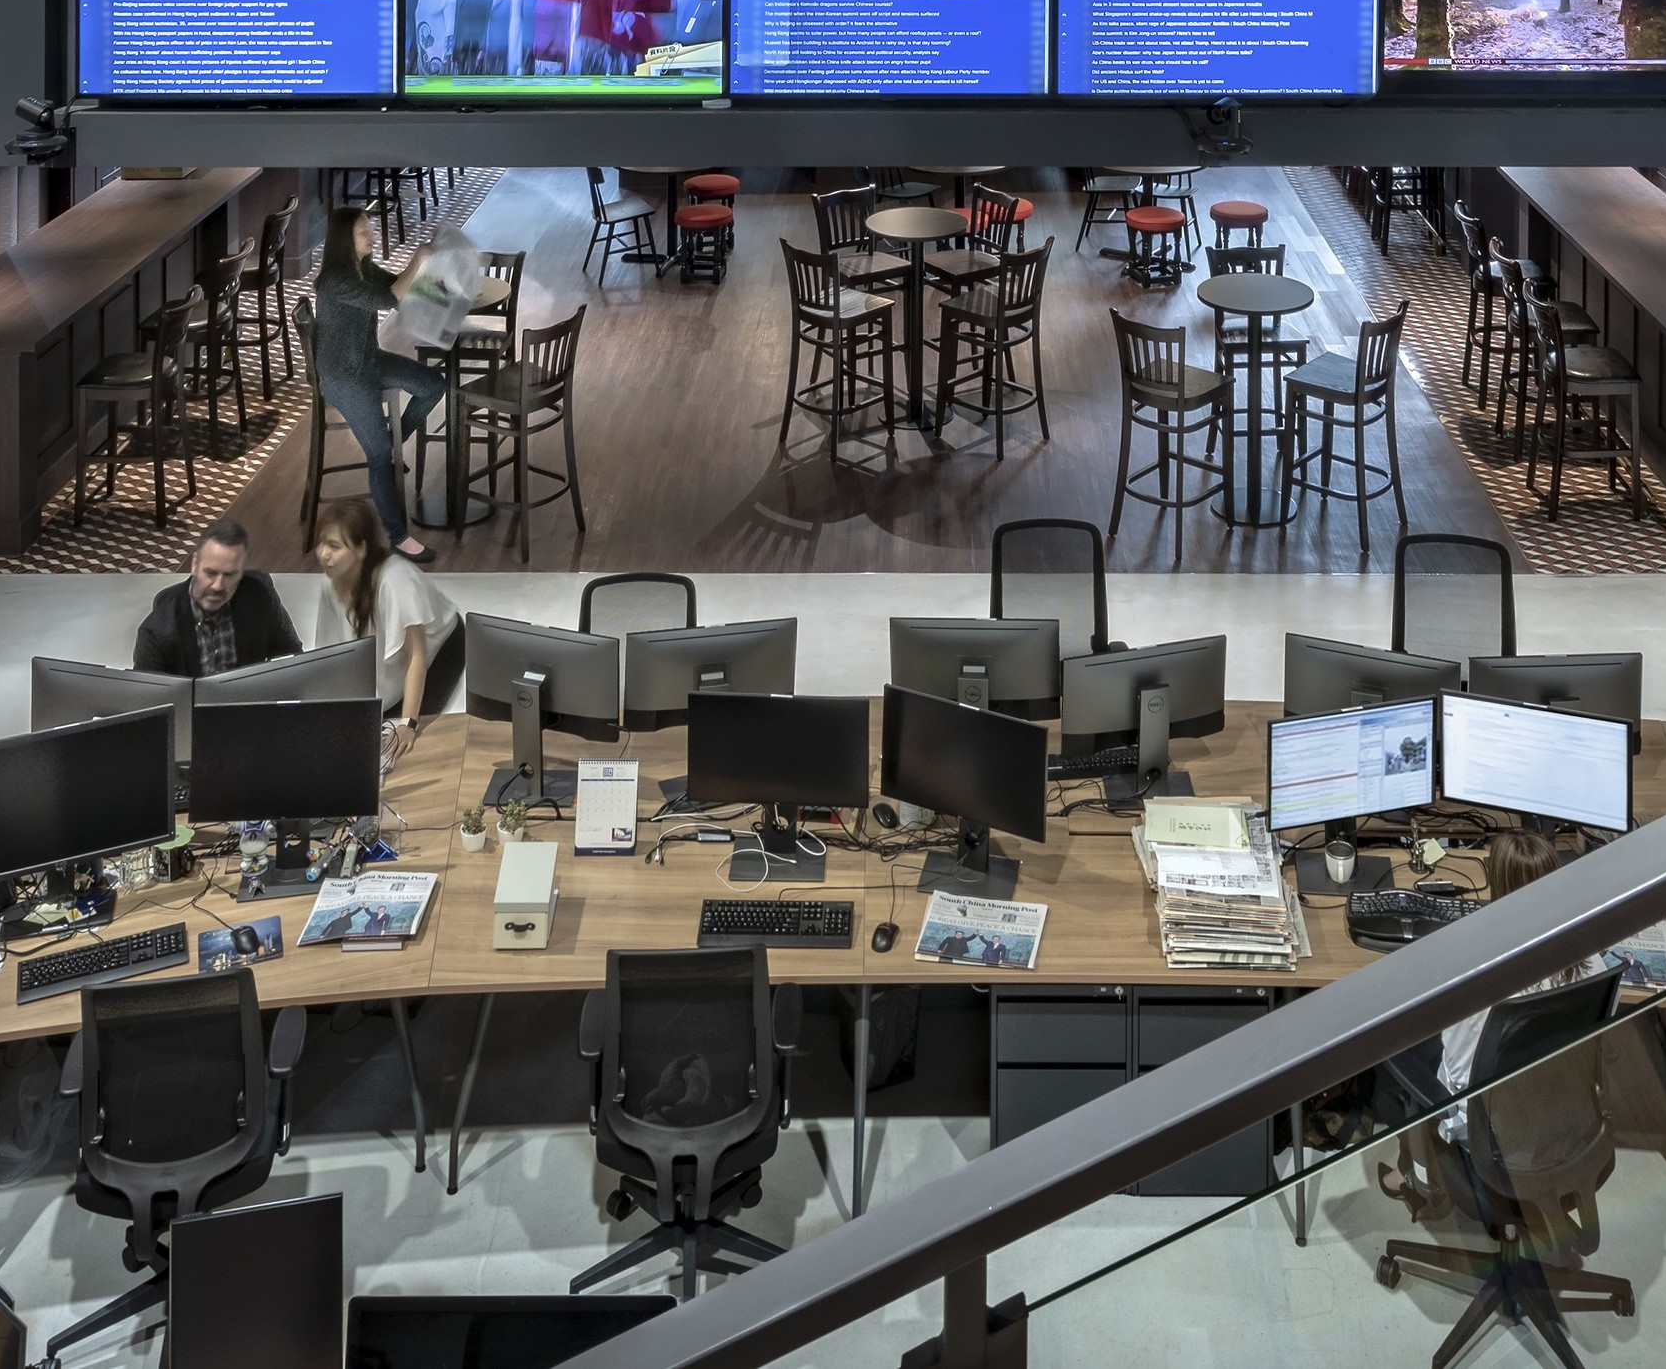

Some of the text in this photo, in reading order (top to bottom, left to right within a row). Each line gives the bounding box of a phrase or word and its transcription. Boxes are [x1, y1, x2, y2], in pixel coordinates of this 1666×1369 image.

[939, 895, 1038, 913] South China Morning Post
[1633, 941, 1665, 949] CHANCE
